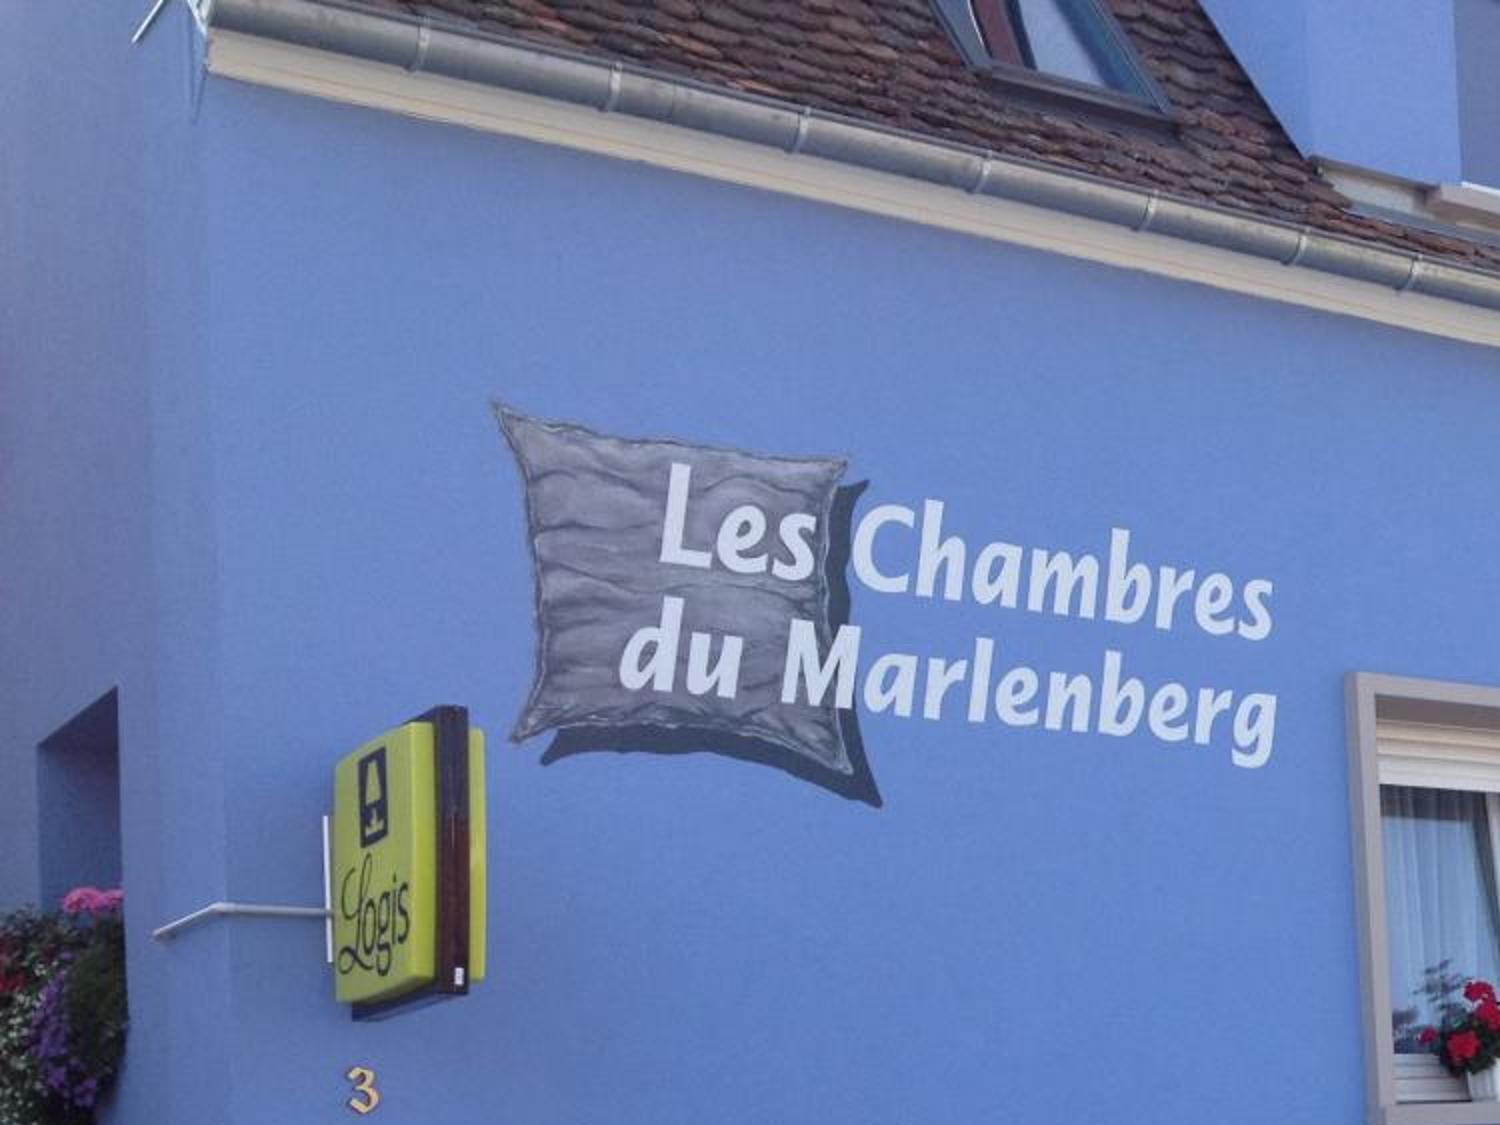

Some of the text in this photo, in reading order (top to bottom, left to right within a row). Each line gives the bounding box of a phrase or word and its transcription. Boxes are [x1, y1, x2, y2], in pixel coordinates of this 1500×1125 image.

[659, 461, 1275, 642] Les Chambres
[618, 595, 1278, 769] du Marlenberg
[337, 852, 410, 977] Logis
[349, 1066, 381, 1115] 3
